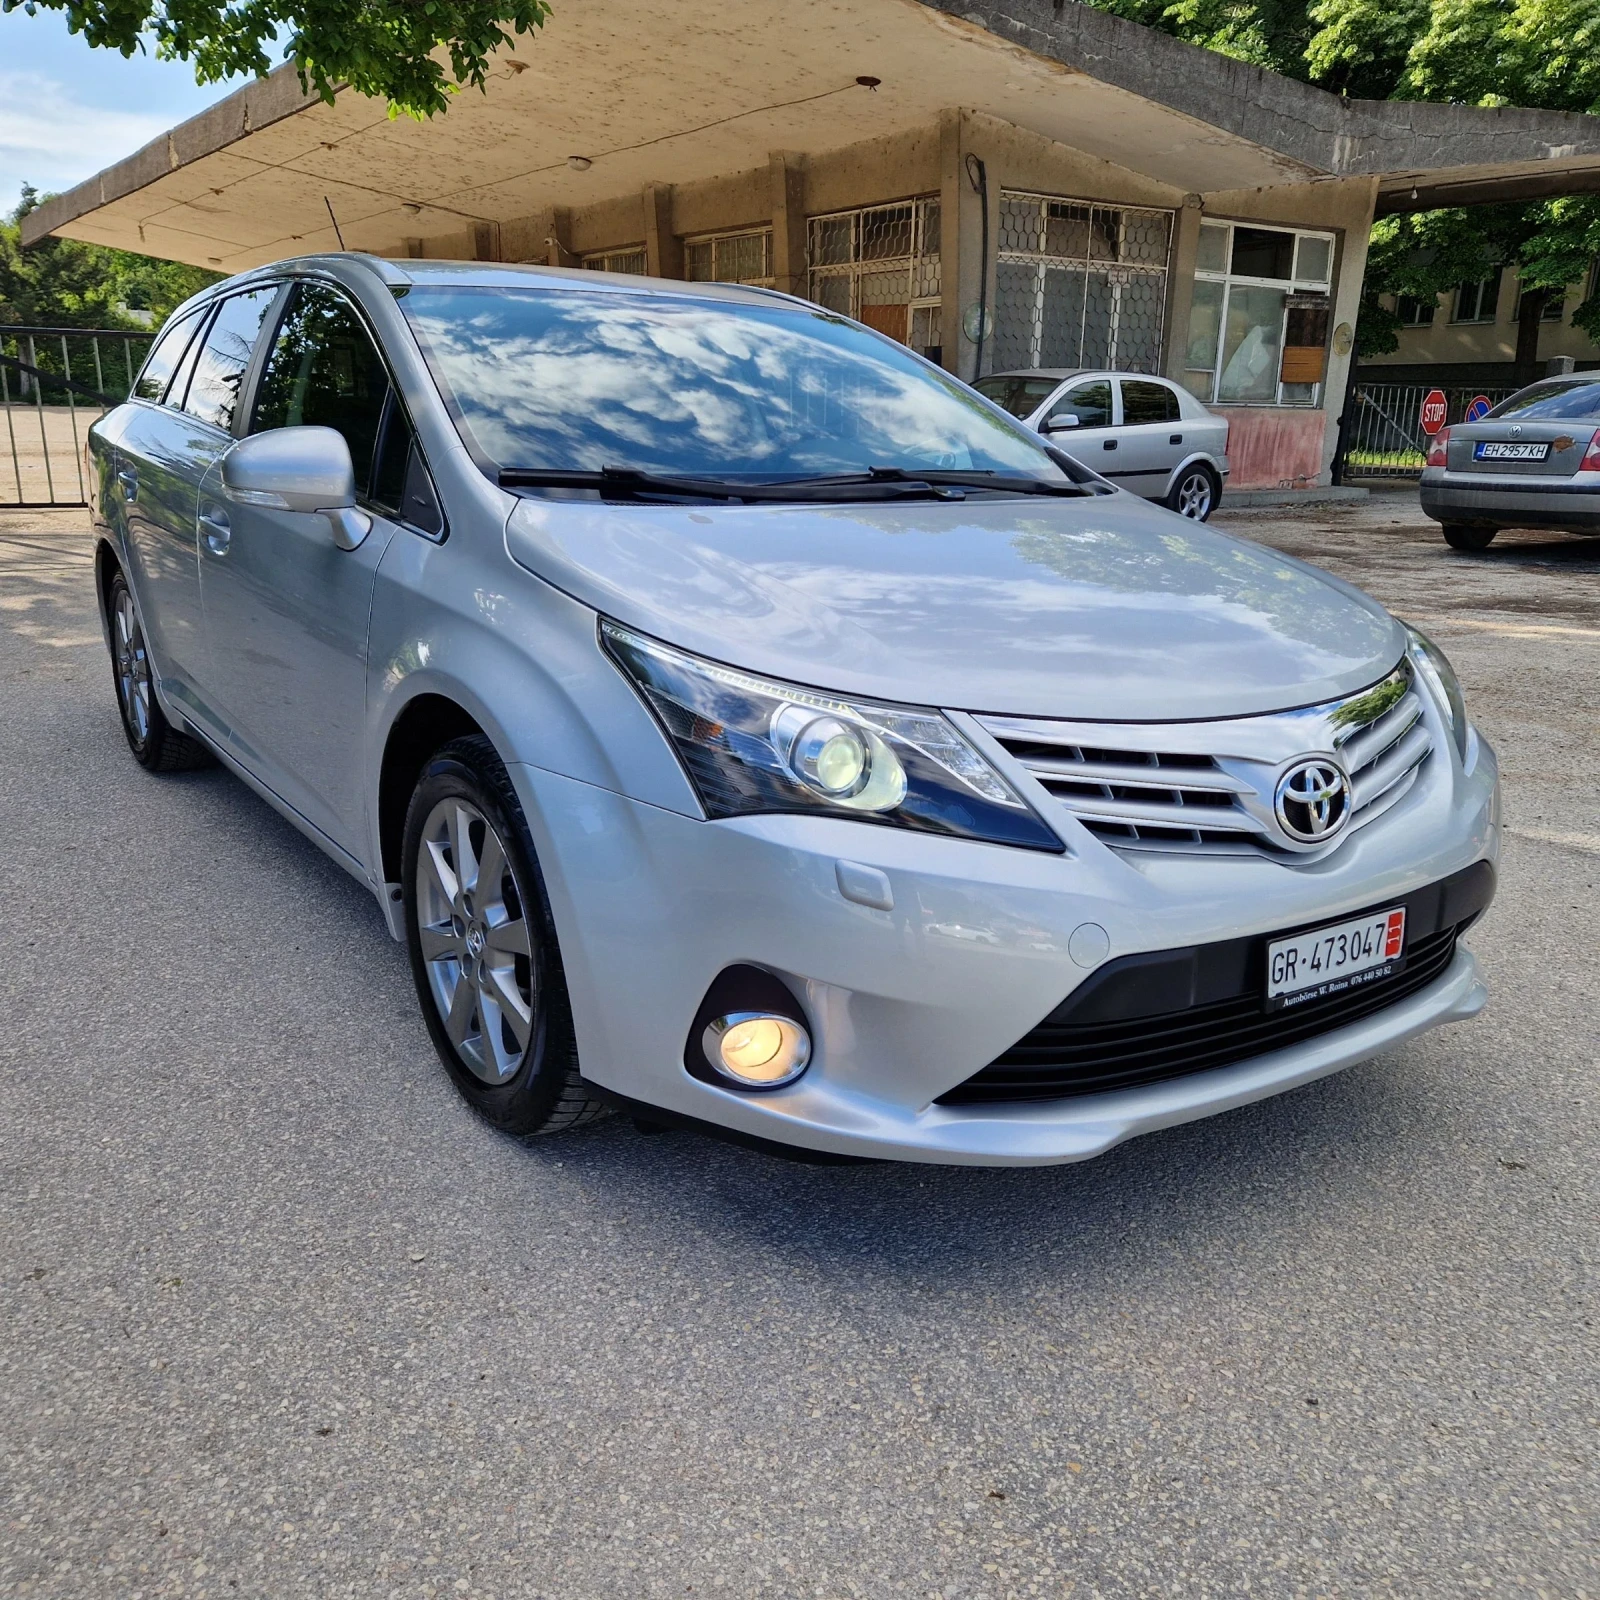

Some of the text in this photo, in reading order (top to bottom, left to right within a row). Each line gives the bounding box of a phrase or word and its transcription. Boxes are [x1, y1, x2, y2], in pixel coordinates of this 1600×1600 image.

[1425, 403, 1444, 422] STOP
[1283, 990, 1318, 1007] Autobörse
[1350, 975, 1363, 985] 076
[1363, 971, 1375, 982] 440
[1375, 969, 1383, 978] 50
[1383, 965, 1391, 975] 82
